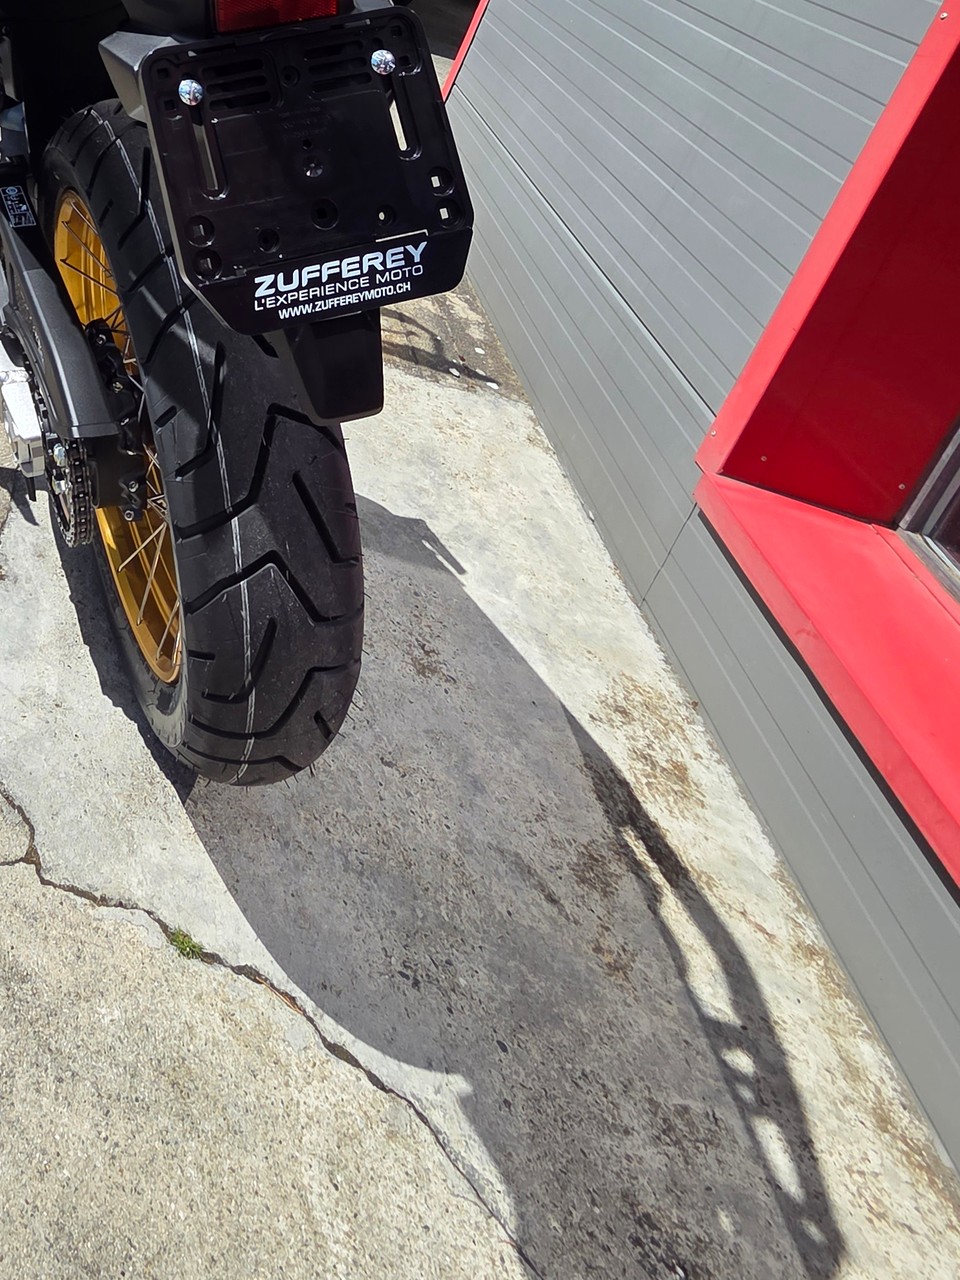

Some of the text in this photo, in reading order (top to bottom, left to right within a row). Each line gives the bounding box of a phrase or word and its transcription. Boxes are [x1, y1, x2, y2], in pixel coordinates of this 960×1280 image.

[254, 241, 428, 298] ZUFFEREY
[254, 264, 424, 312] L'EXPERIENCE MOTO
[278, 281, 411, 320] WWW.ZUFFEREYMOTO.CH
